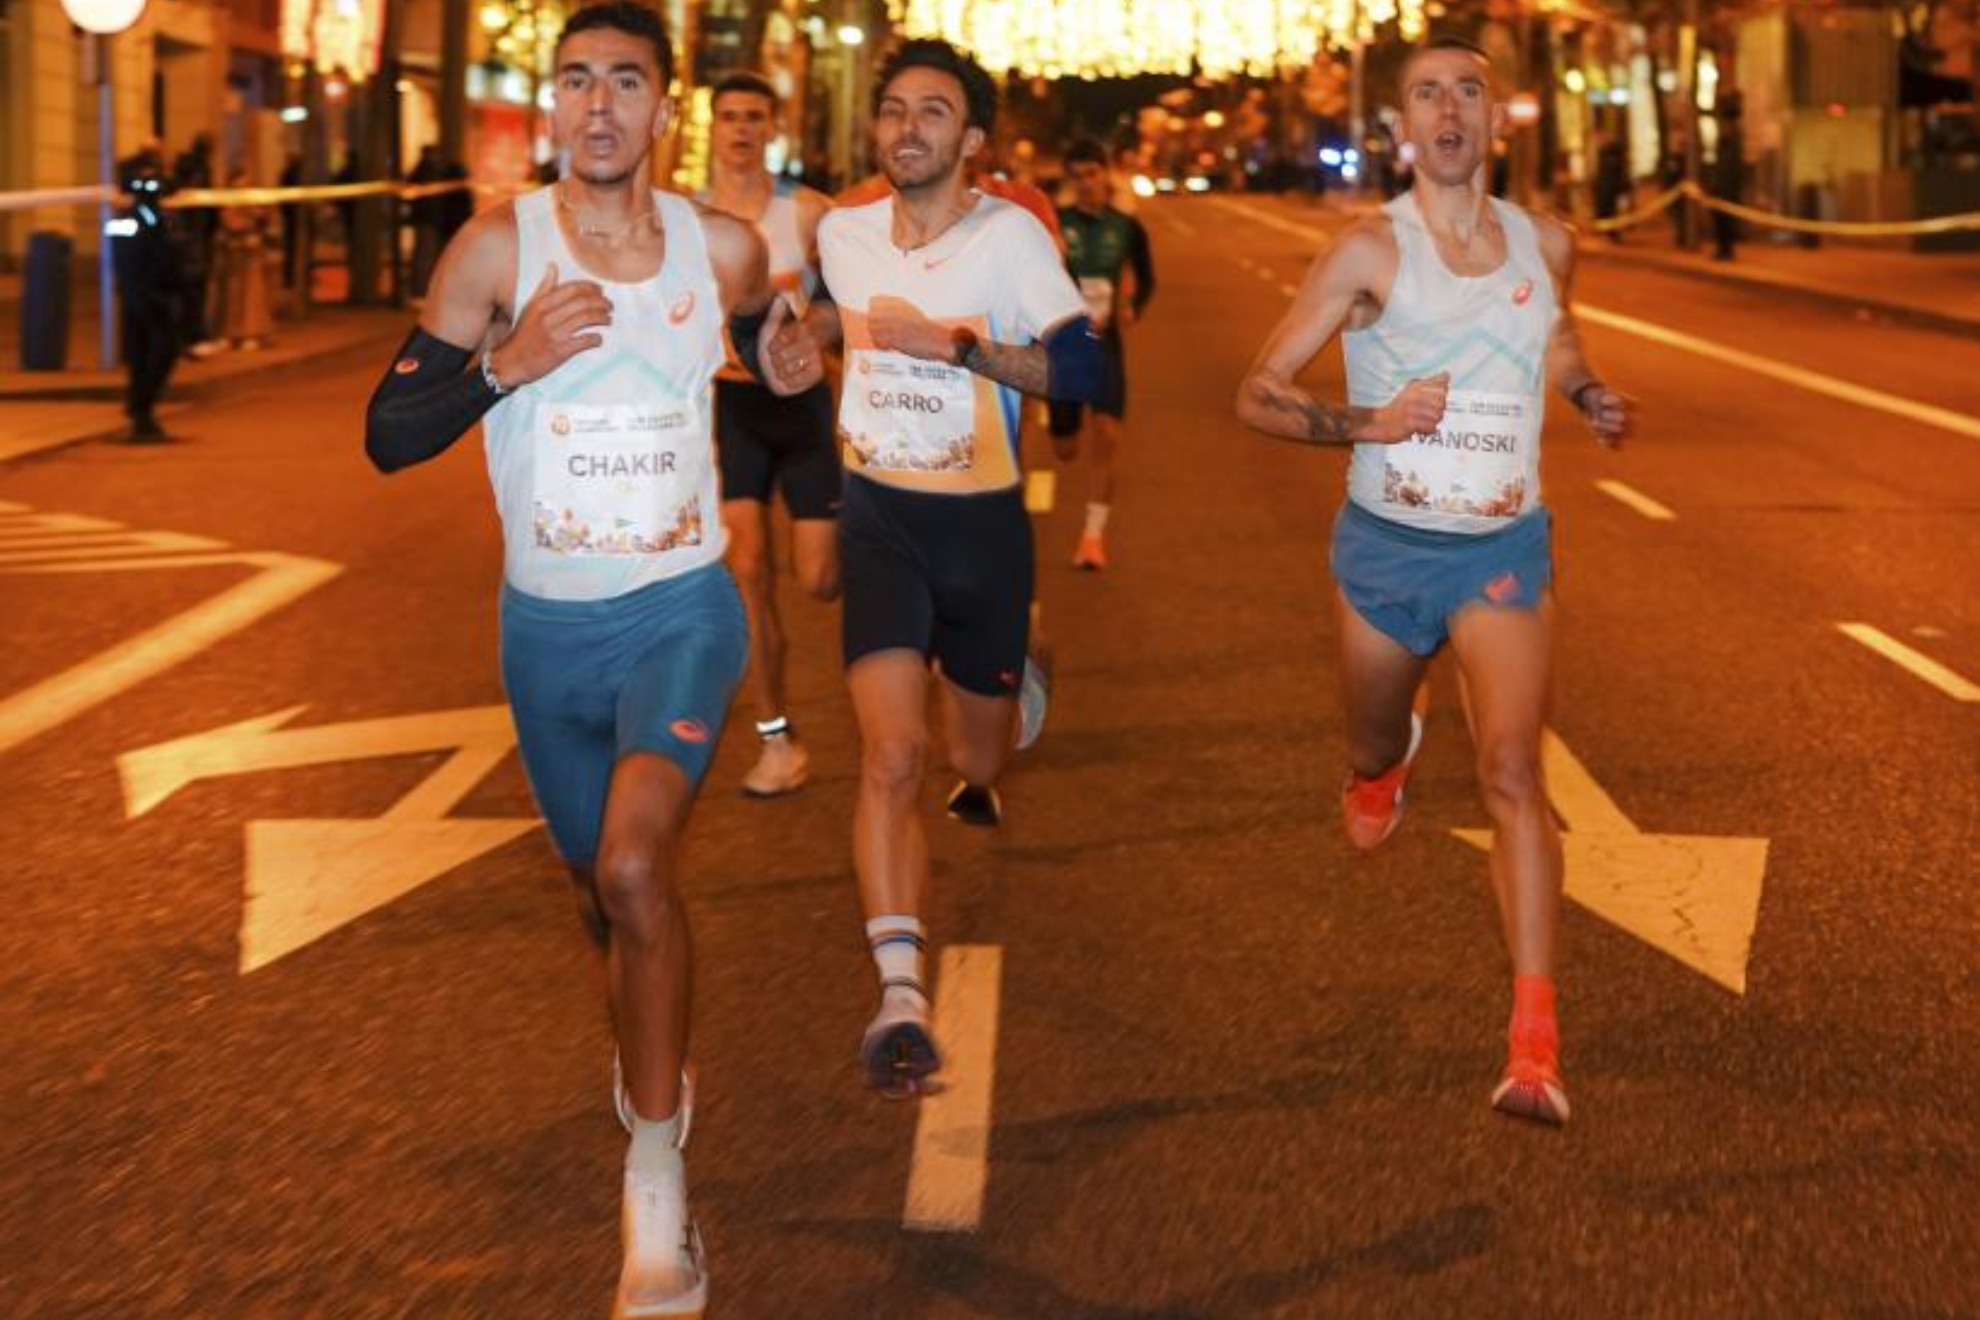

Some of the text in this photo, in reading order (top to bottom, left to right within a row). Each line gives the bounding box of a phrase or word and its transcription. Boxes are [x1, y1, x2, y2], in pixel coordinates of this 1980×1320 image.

[869, 390, 944, 413] CARRO
[1416, 430, 1516, 453] VANOSKI
[567, 451, 676, 478] CHAKIR
